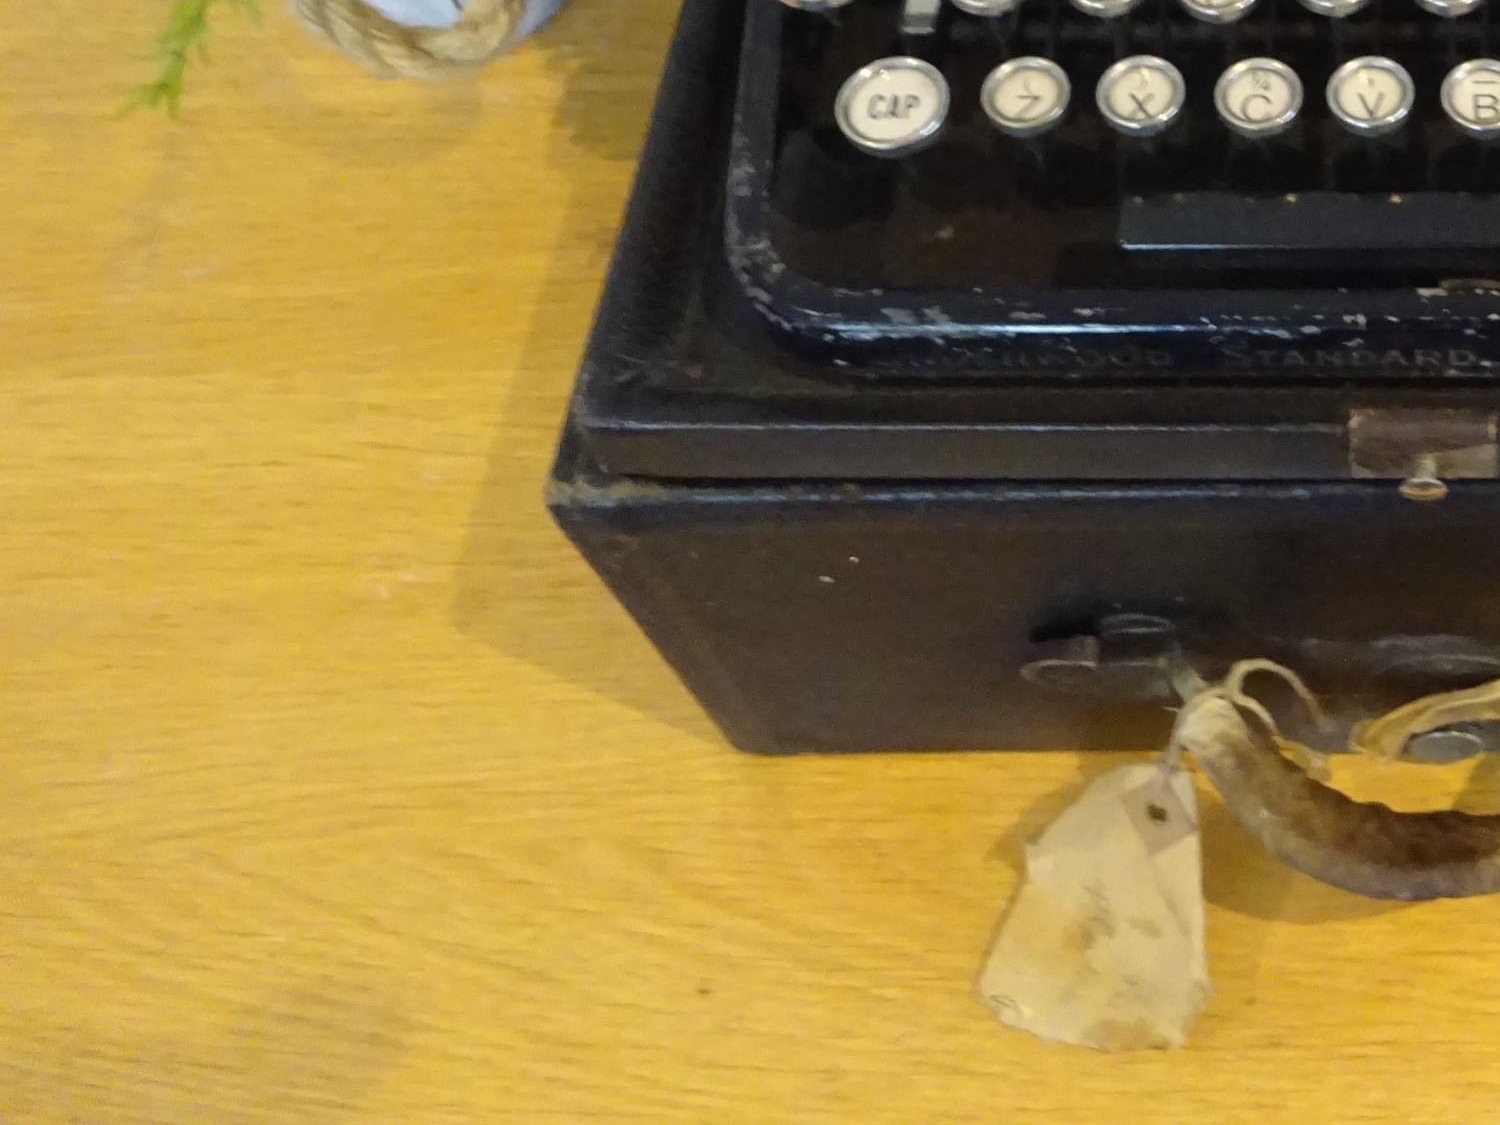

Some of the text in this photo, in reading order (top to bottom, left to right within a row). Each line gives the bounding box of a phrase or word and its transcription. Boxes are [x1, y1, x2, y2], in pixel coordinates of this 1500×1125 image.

[866, 93, 920, 121] CAP
[1128, 92, 1156, 120] X
[1240, 93, 1274, 123] C
[1357, 91, 1386, 119] V
[1473, 92, 1500, 121] B
